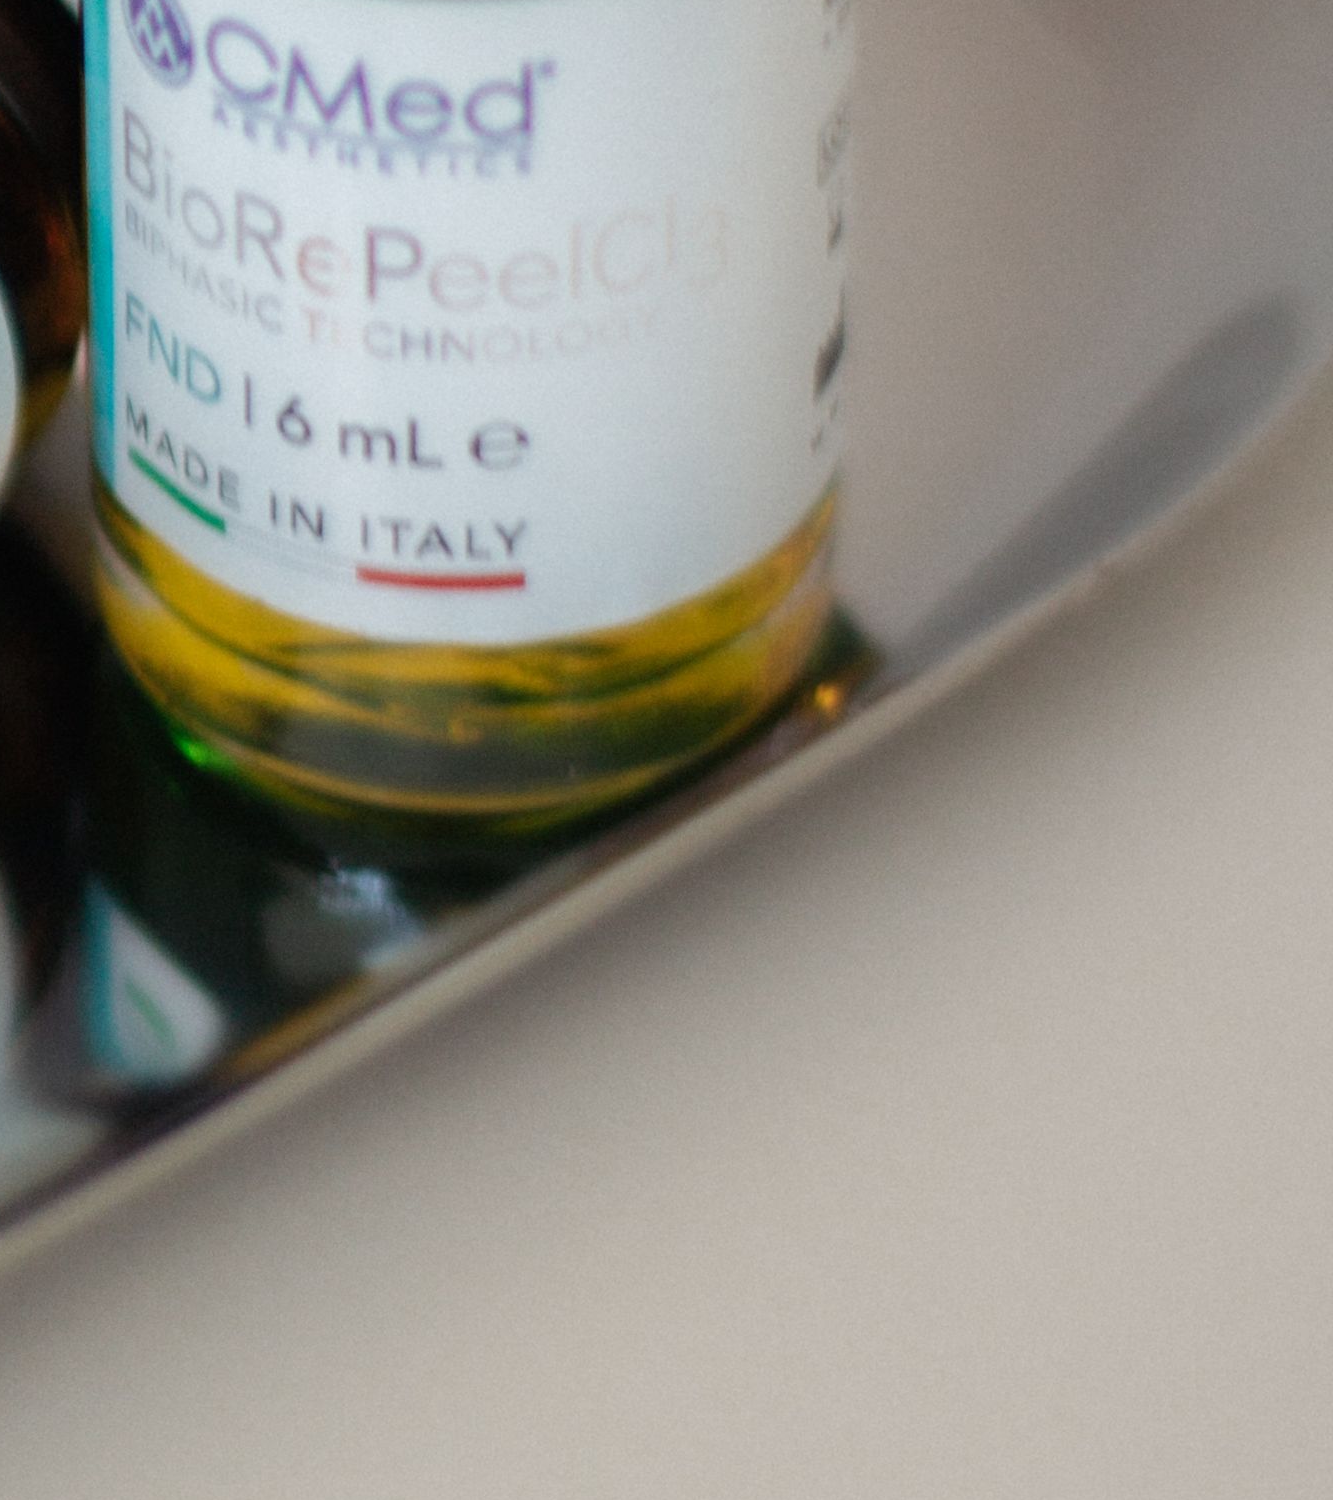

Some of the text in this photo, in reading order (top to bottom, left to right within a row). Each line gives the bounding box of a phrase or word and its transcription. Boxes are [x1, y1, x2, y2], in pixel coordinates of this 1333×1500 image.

[123, 291, 224, 405] FND
[275, 391, 314, 448] 6
[338, 415, 445, 471] mL
[124, 395, 529, 562] MADE IN ITALY
